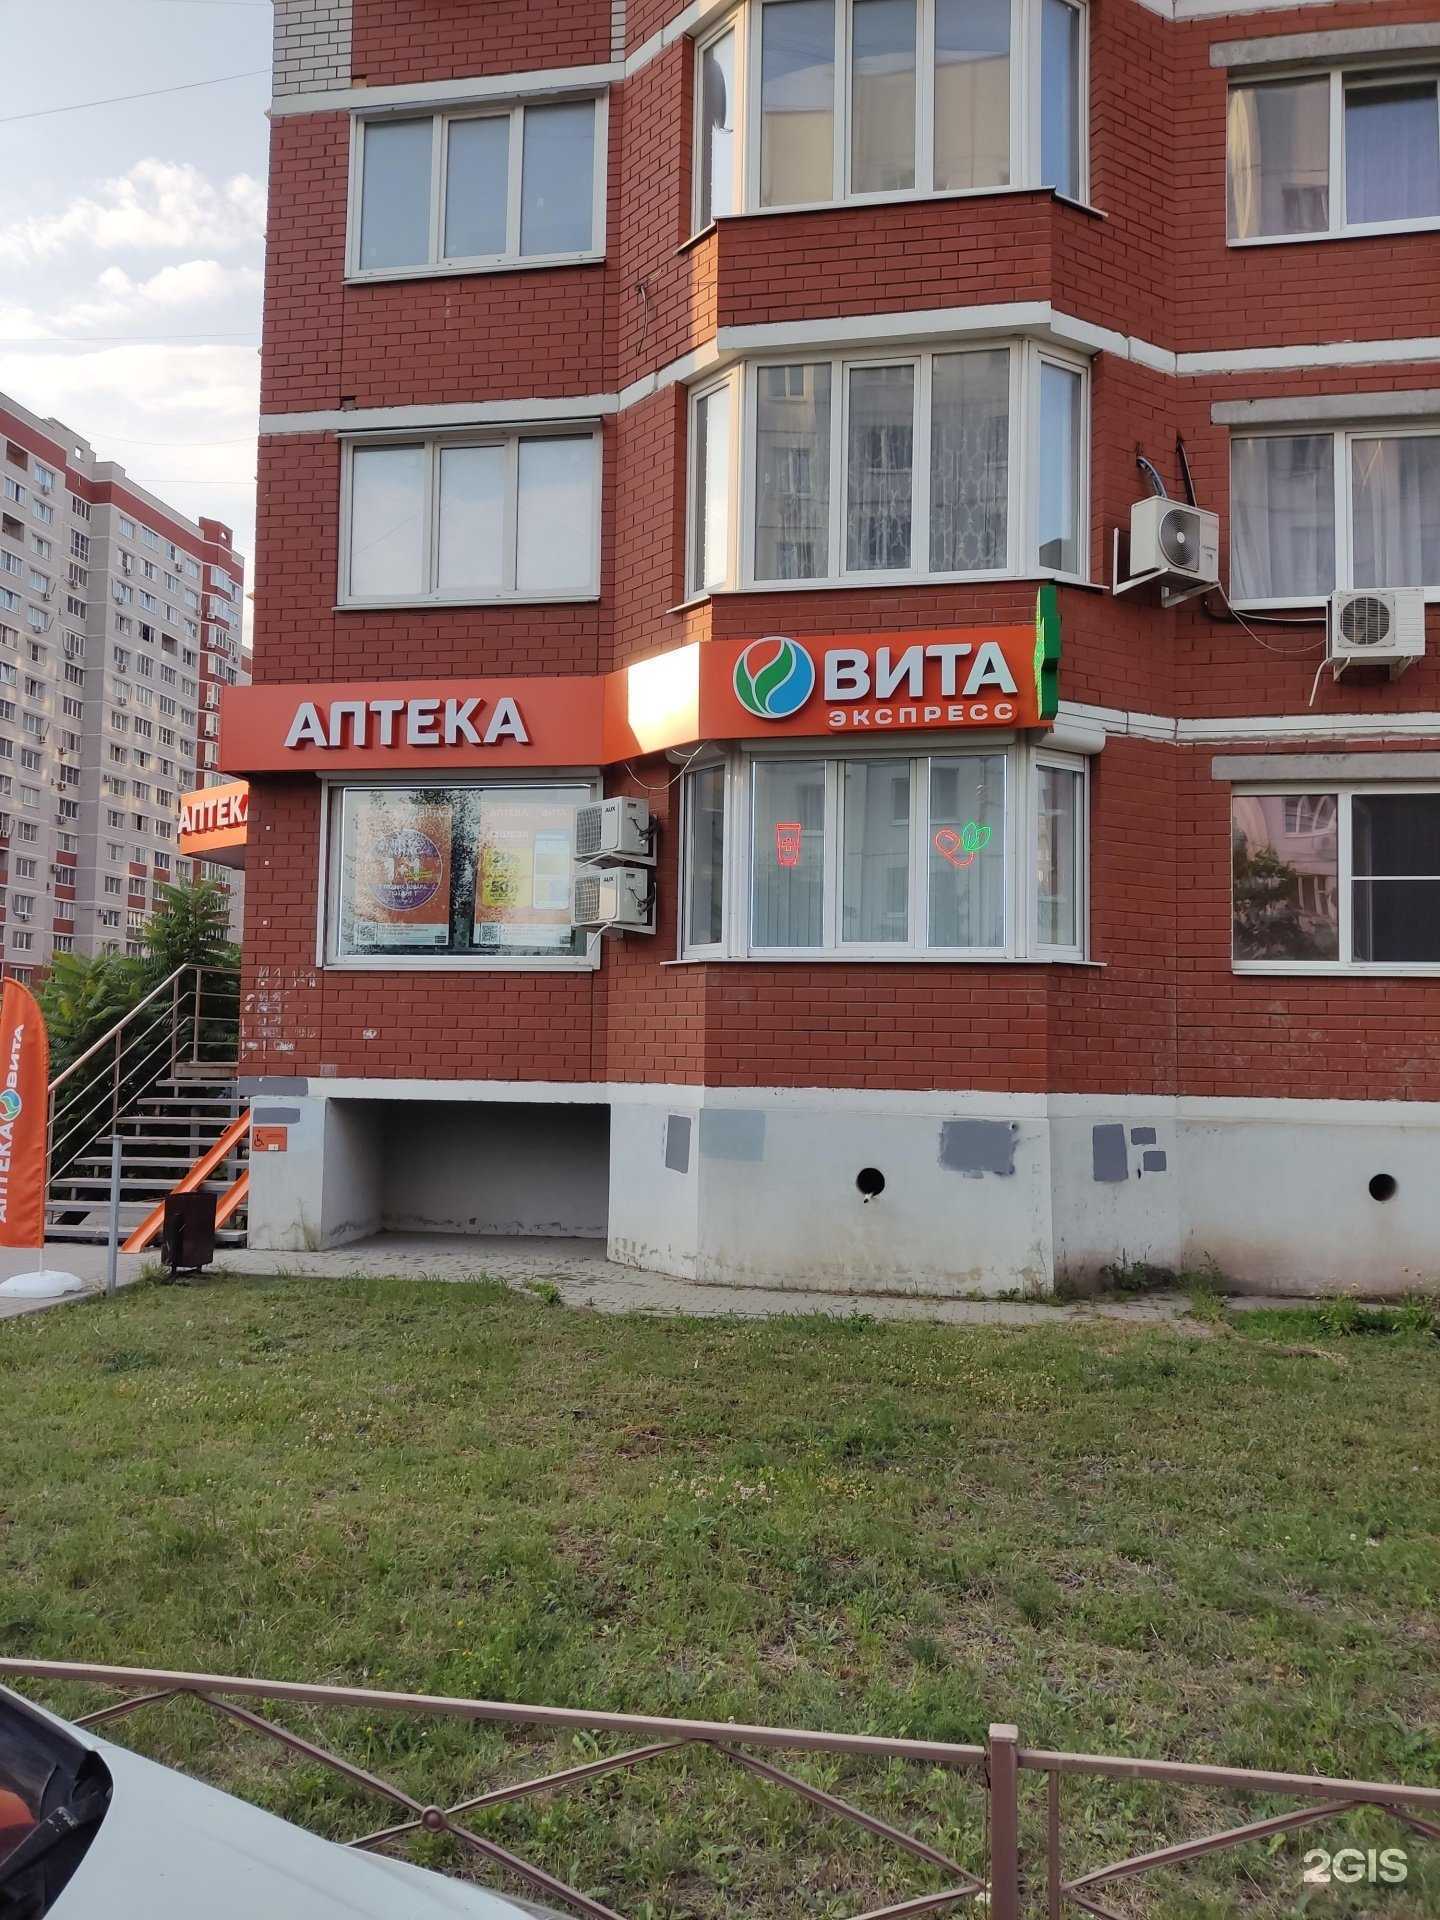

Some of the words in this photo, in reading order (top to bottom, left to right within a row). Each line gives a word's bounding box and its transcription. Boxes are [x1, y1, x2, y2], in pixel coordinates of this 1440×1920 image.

[824, 641, 1018, 701] ВИТА
[284, 697, 529, 748] АПТЕКА
[828, 703, 1014, 727] ЭКСПРЕСС
[7, 1024, 24, 1089] ВИТА
